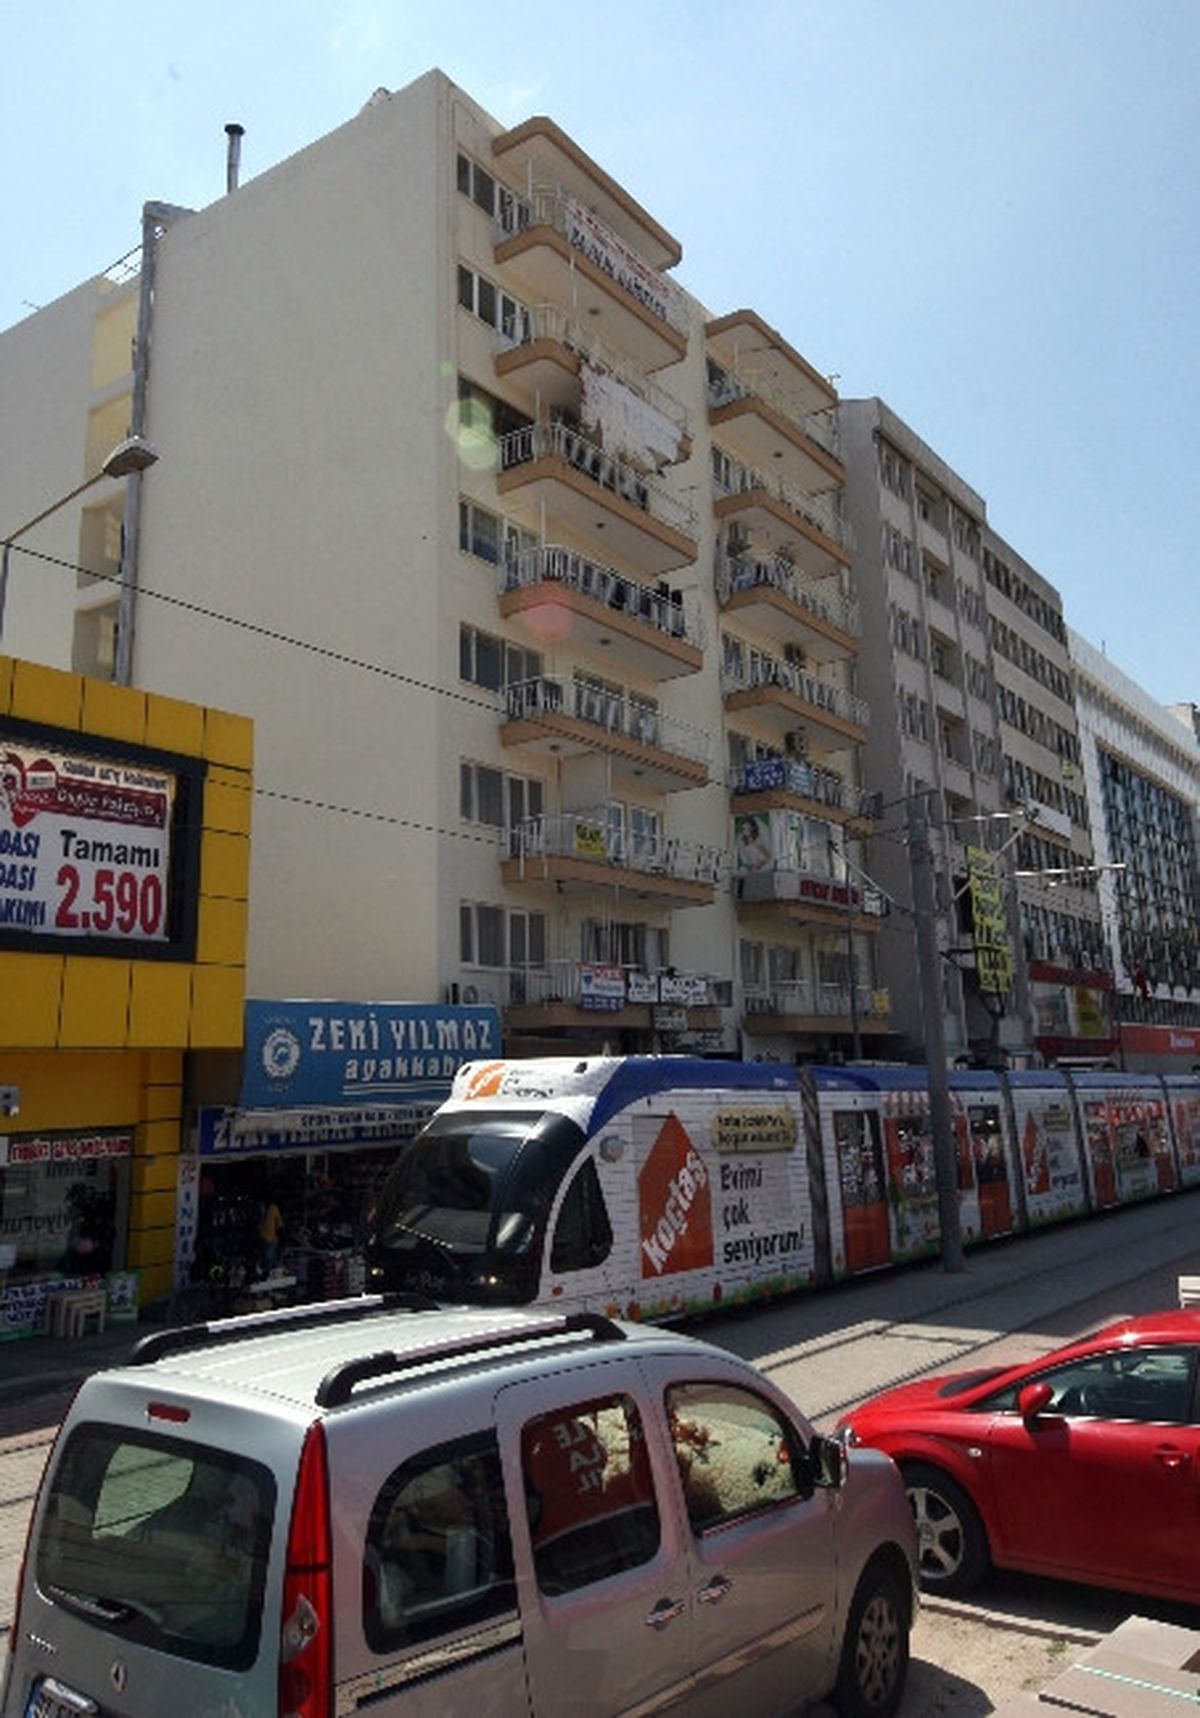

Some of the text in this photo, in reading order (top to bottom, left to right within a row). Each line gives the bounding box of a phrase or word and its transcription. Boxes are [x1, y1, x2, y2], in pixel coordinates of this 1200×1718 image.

[60, 829, 159, 868] Tamamı
[55, 863, 162, 935] 2.590
[309, 1012, 492, 1050] ZEKİ YILMAZ
[721, 1161, 763, 1190] Evimi
[723, 1197, 752, 1232] çok
[723, 1222, 805, 1265] seviyorum!
